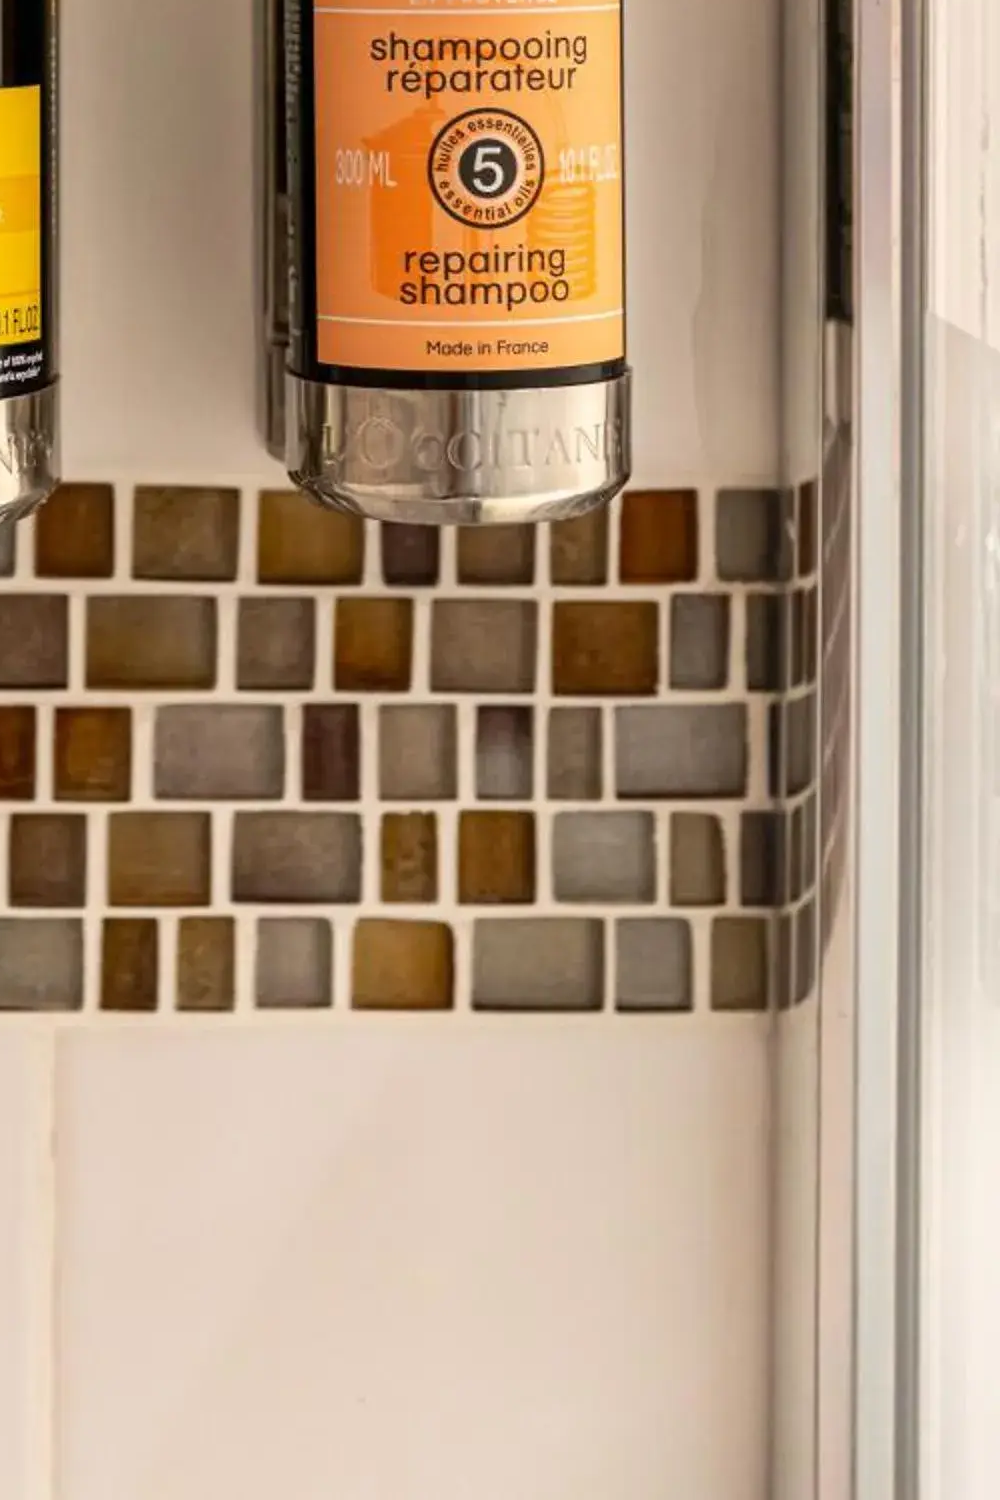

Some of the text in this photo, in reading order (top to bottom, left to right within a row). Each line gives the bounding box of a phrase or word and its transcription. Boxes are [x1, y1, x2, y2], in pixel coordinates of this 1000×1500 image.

[370, 30, 588, 65] shampooing
[387, 62, 577, 99] réparateur
[435, 117, 536, 172] huiles essentielles
[336, 148, 398, 188] 300 ML
[473, 147, 504, 193] 5
[439, 179, 535, 221] essential oils
[404, 244, 565, 278] repairing
[399, 276, 570, 311] shampoo
[426, 339, 549, 355] Made in France
